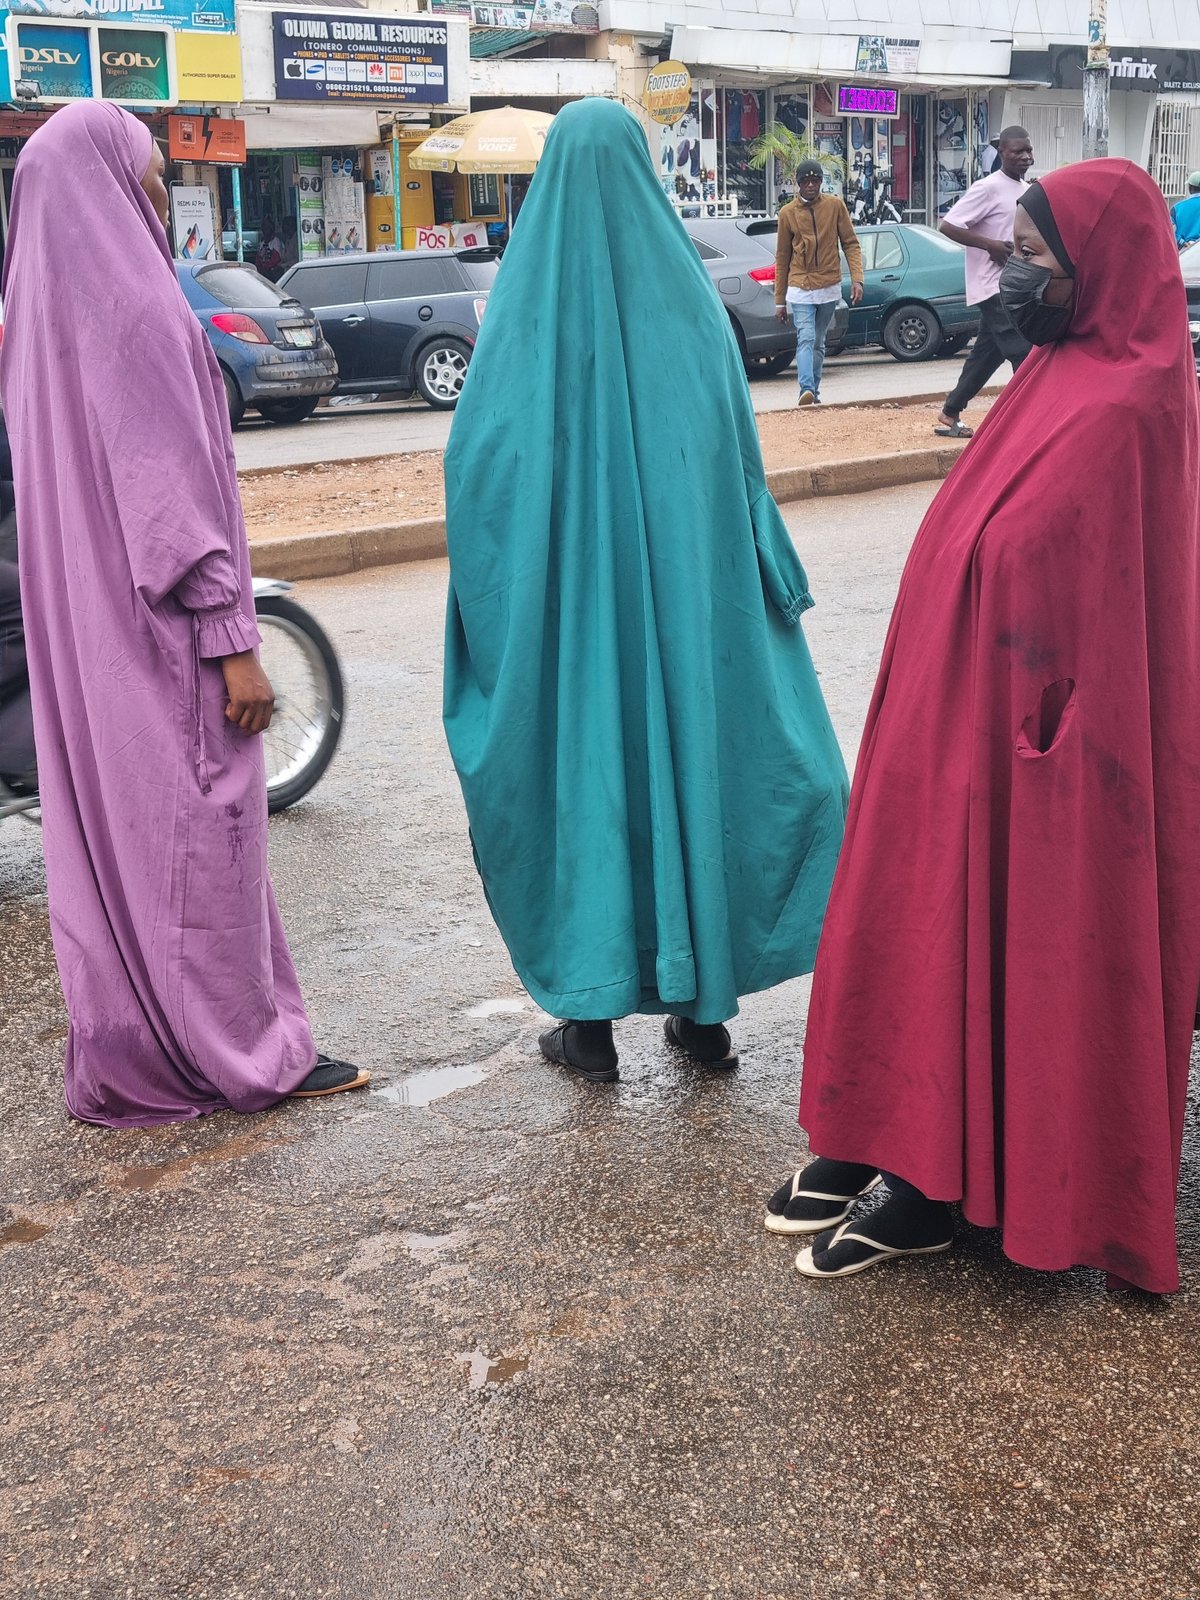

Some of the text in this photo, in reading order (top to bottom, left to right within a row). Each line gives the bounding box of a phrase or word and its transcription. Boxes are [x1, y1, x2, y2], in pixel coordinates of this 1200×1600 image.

[283, 19, 447, 45] OLUWA GLOBAL RESOURCES
[303, 41, 425, 55] (TONERO COMMUNICATIONS)
[20, 64, 44, 73] Nigeria
[105, 67, 129, 76] Nigeria
[647, 72, 688, 92] FOOTSTEPS
[478, 143, 517, 152] VOICE
[418, 231, 446, 249] POS
